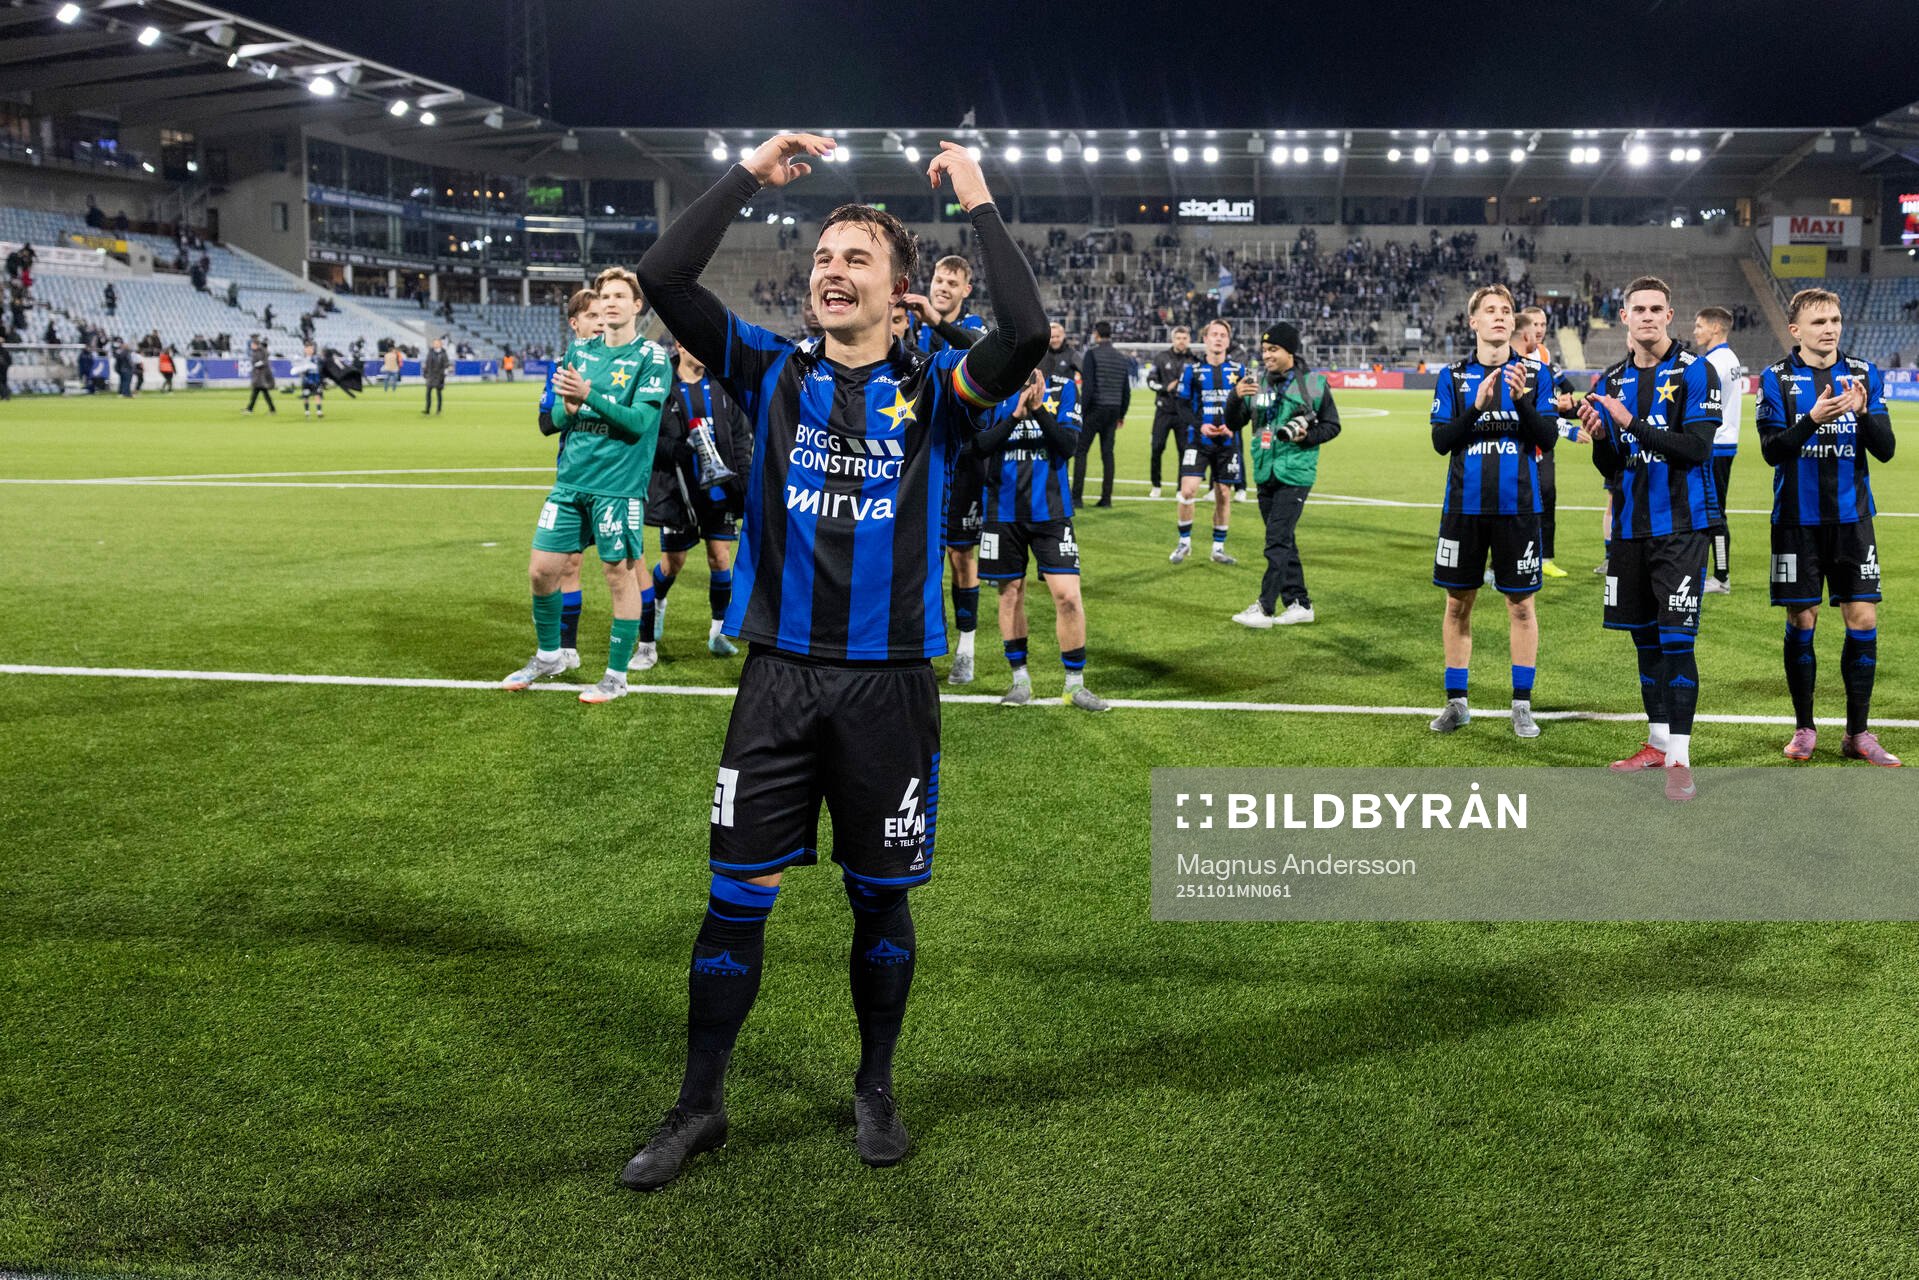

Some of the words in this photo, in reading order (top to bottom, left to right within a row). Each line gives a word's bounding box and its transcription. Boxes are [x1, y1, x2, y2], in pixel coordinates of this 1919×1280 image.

[1179, 199, 1254, 216] stadium
[1790, 217, 1844, 234] MAXI
[795, 424, 841, 452] BYGG
[1467, 441, 1518, 456] mirva
[1801, 444, 1856, 458] mirva
[789, 447, 905, 479] CONSTRUCT
[786, 485, 894, 521] mirva
